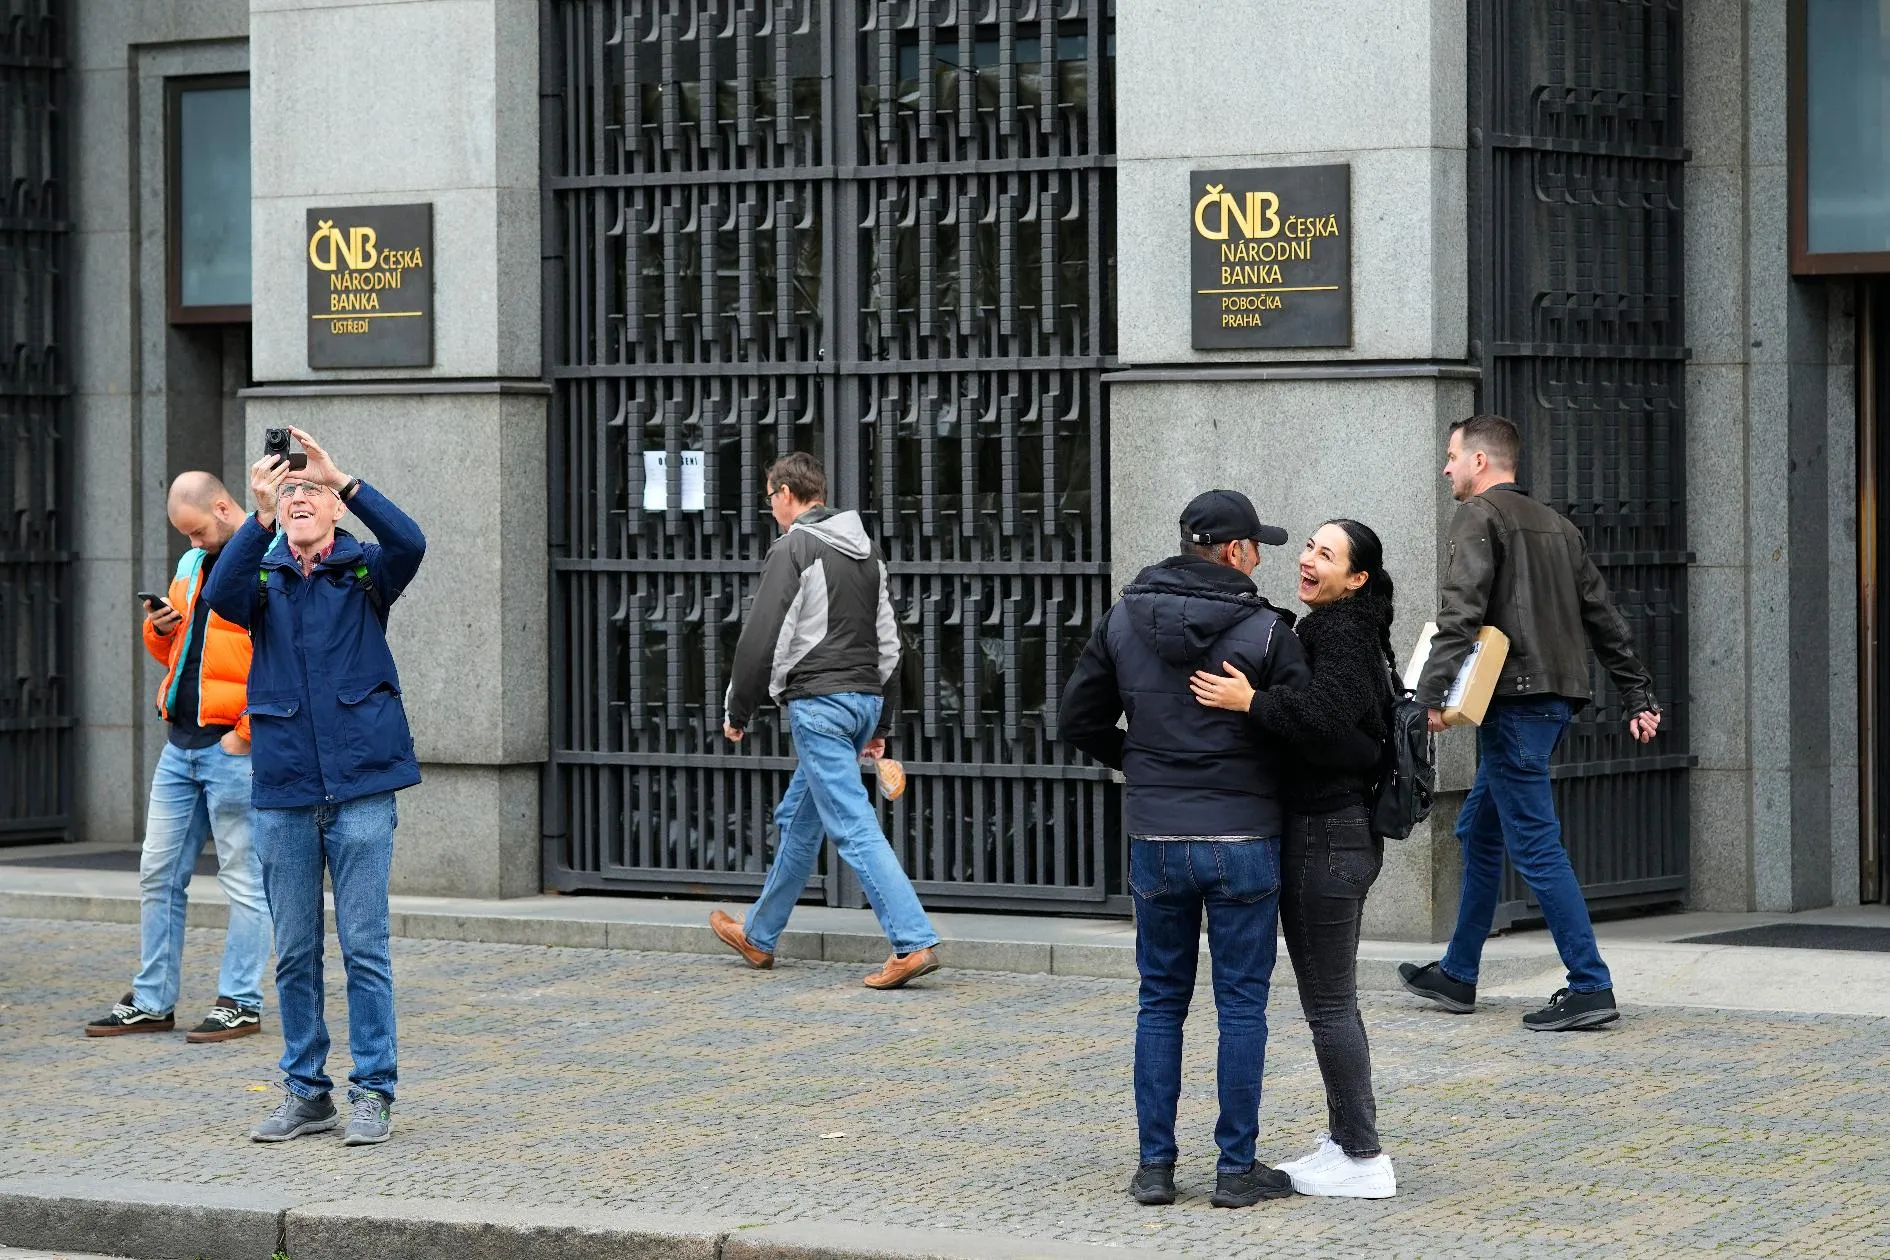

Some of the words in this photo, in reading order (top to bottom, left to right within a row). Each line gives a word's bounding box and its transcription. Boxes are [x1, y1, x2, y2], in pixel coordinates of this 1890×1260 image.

[1194, 184, 1281, 240] ČNB
[1284, 214, 1339, 238] ČESKÁ
[309, 219, 378, 271] ČNB
[380, 247, 423, 269] ČESKÁ
[1221, 238, 1312, 263] NÁRODNÍ
[330, 269, 401, 290] NÁRODNÍ
[1221, 265, 1282, 285] BANKA
[330, 293, 379, 311] BANKA
[1221, 293, 1282, 311] POBOČKA
[331, 318, 369, 334] ÚSTŘEDÍ
[1222, 314, 1261, 327] PRAHA
